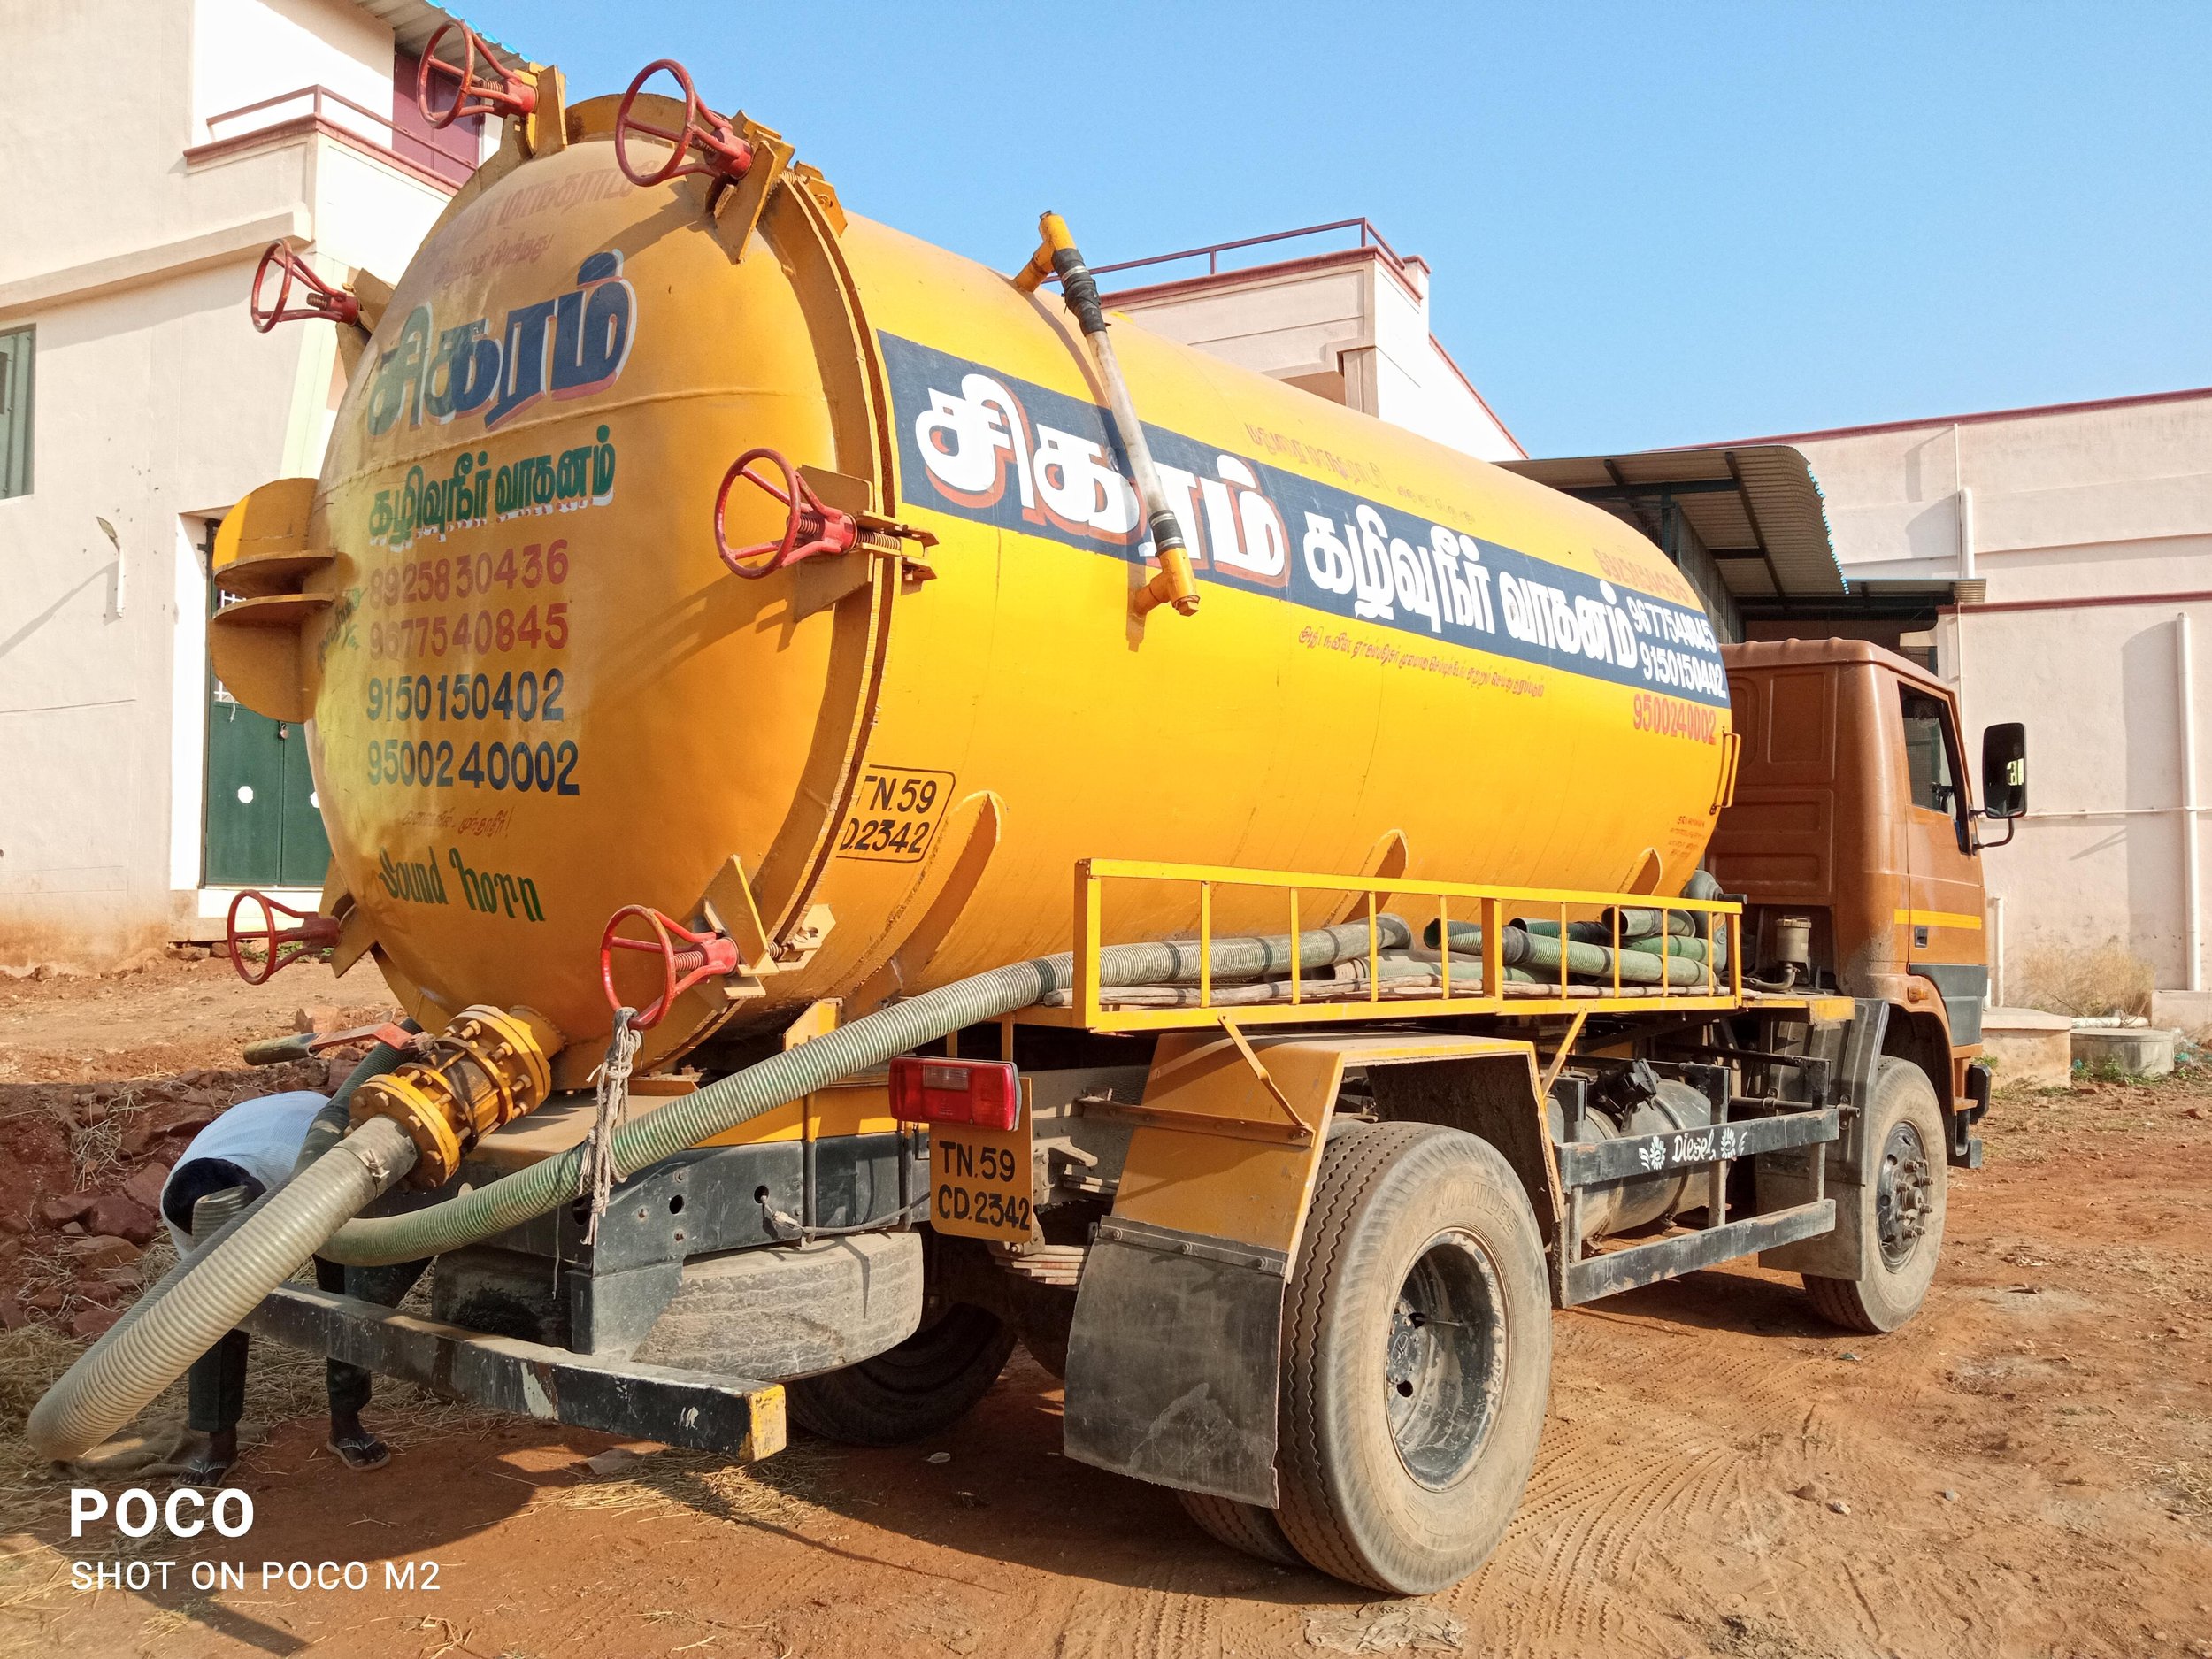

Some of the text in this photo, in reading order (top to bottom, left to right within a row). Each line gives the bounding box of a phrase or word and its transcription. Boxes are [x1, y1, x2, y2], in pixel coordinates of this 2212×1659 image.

[366, 249, 637, 436] சிகரம்
[369, 425, 615, 552] கழிவுநீர் வாகனம்
[369, 538, 569, 611] 8925830436
[1303, 504, 1638, 669] கழிவுநீர் வாகனம்
[369, 603, 569, 661] 9677540845
[1626, 596, 1717, 653] 9677540845
[365, 668, 565, 722] 9150150402
[1640, 641, 1727, 698] 9150150402
[1633, 694, 1717, 746] 9500240002
[366, 740, 580, 796] 9500240002
[378, 844, 546, 923] Sound horn
[939, 1140, 1016, 1183] TN.59
[938, 1184, 1030, 1231] CD.2342
